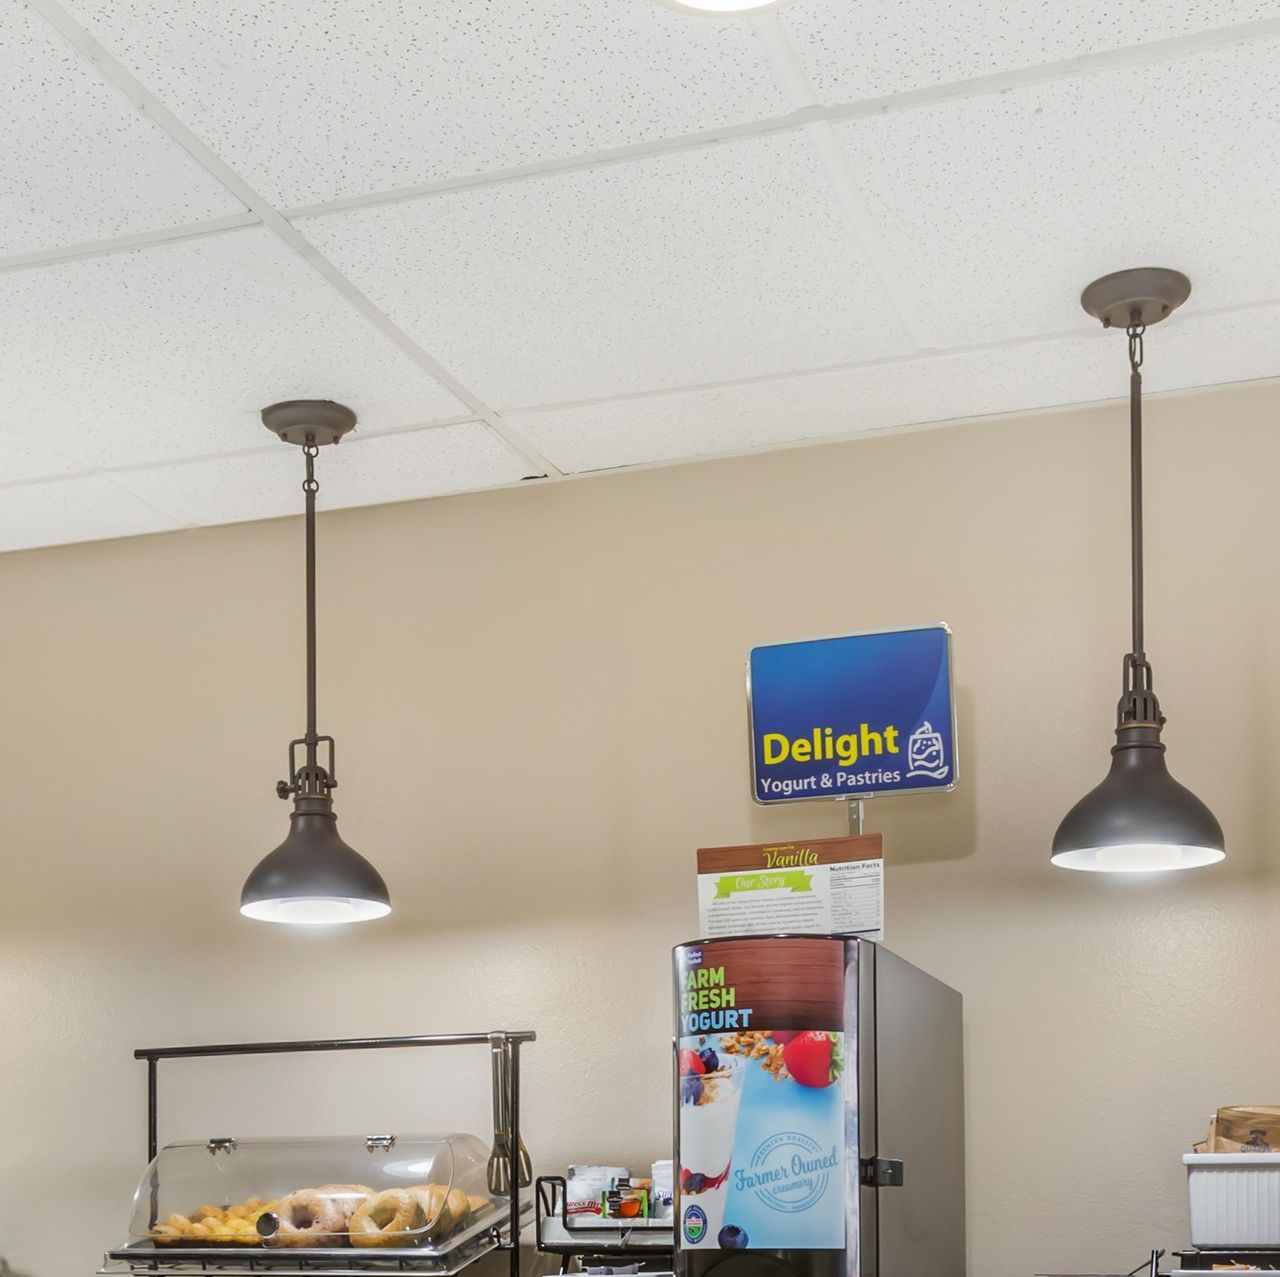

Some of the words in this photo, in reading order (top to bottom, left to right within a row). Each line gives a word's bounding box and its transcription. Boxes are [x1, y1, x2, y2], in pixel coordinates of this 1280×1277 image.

[763, 723, 900, 767] Delight
[760, 775, 817, 795] Yogurt
[820, 773, 833, 788] &
[836, 768, 901, 787] Pastries
[763, 848, 819, 869] Vanilla
[829, 864, 861, 873] Nutrition
[735, 876, 755, 889] Our
[758, 874, 786, 889] Story
[681, 987, 736, 1013] FRESH
[681, 1008, 753, 1035] YOGURT
[734, 1166, 789, 1191] Farmer
[791, 1144, 839, 1176] Owned
[772, 1177, 813, 1195] creamery
